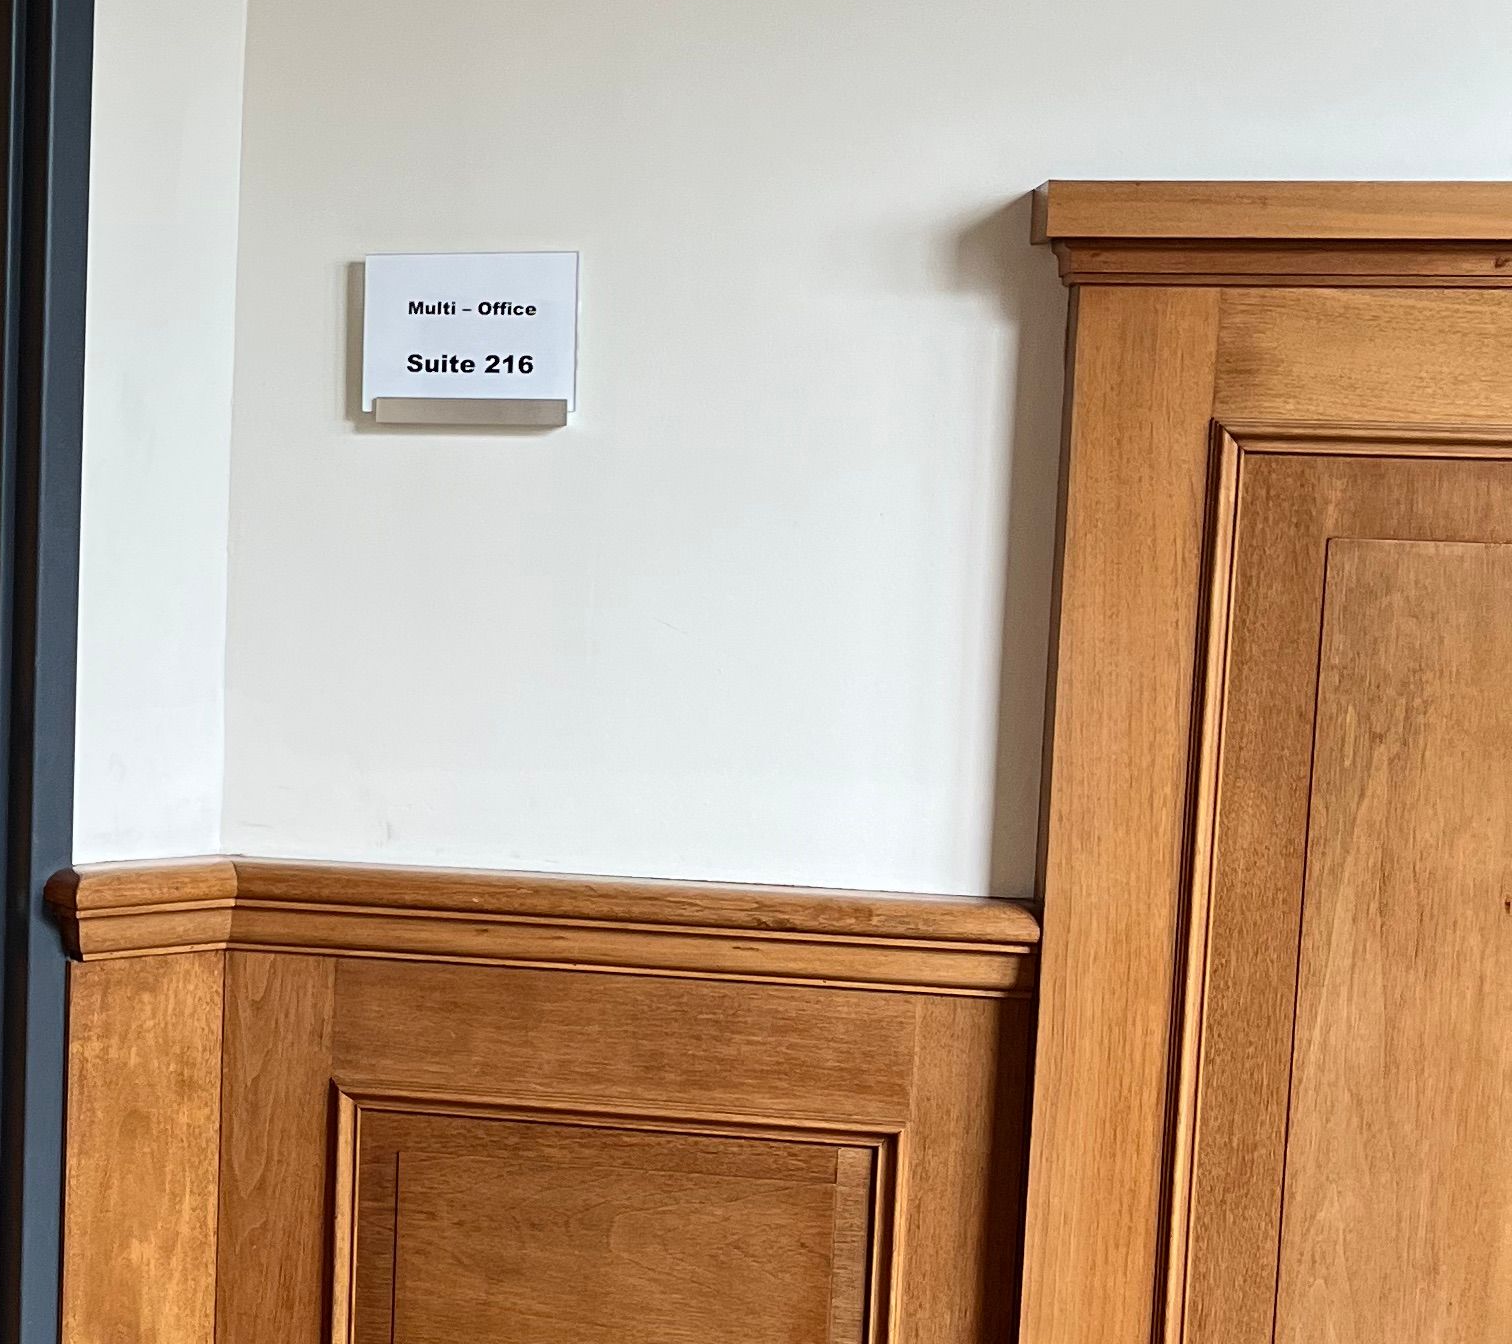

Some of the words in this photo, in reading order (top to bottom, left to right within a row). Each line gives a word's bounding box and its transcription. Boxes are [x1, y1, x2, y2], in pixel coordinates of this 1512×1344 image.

[408, 301, 456, 315] Multi
[477, 301, 537, 316] Office
[406, 354, 476, 374] Suite
[484, 354, 534, 374] 216
